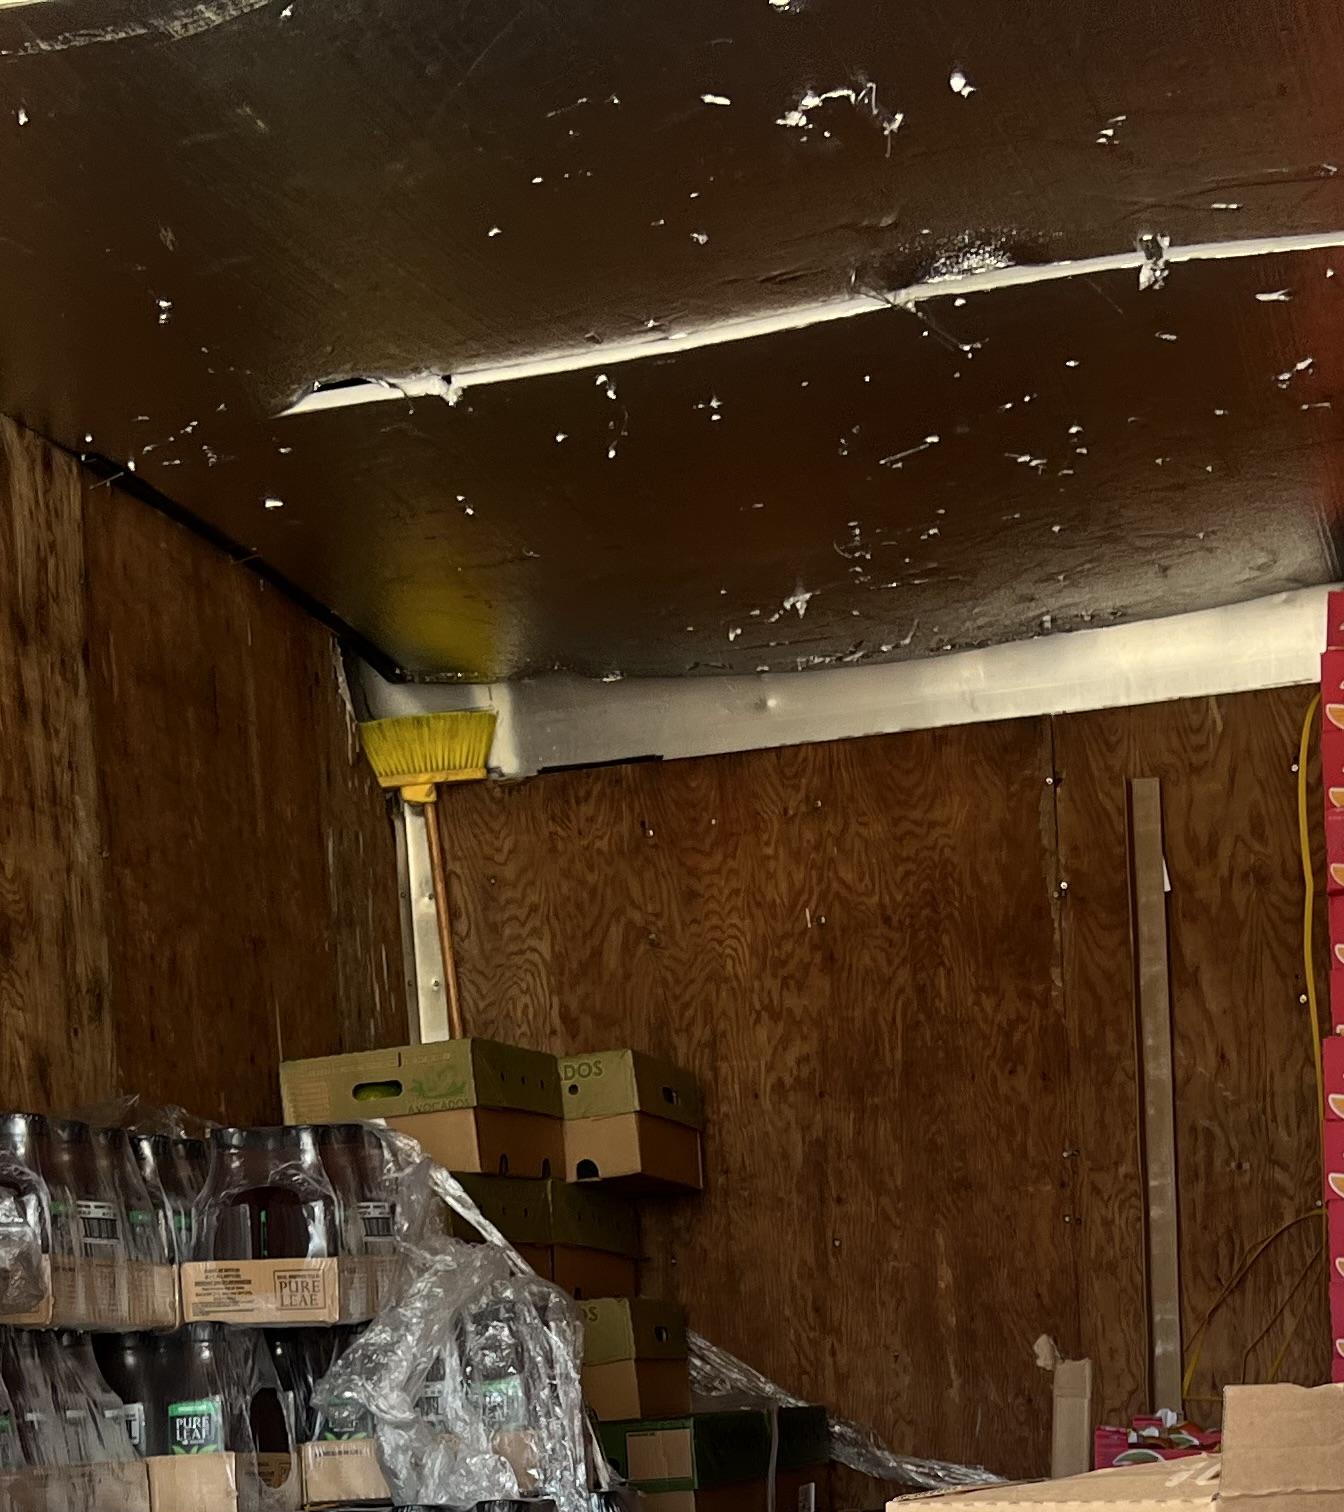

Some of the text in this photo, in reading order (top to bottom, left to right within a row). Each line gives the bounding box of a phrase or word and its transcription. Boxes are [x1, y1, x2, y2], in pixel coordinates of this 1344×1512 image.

[279, 1280, 321, 1294] PURE
[280, 1294, 319, 1307] LEAF
[175, 1416, 210, 1429] PURE
[176, 1428, 209, 1440] LEAF
